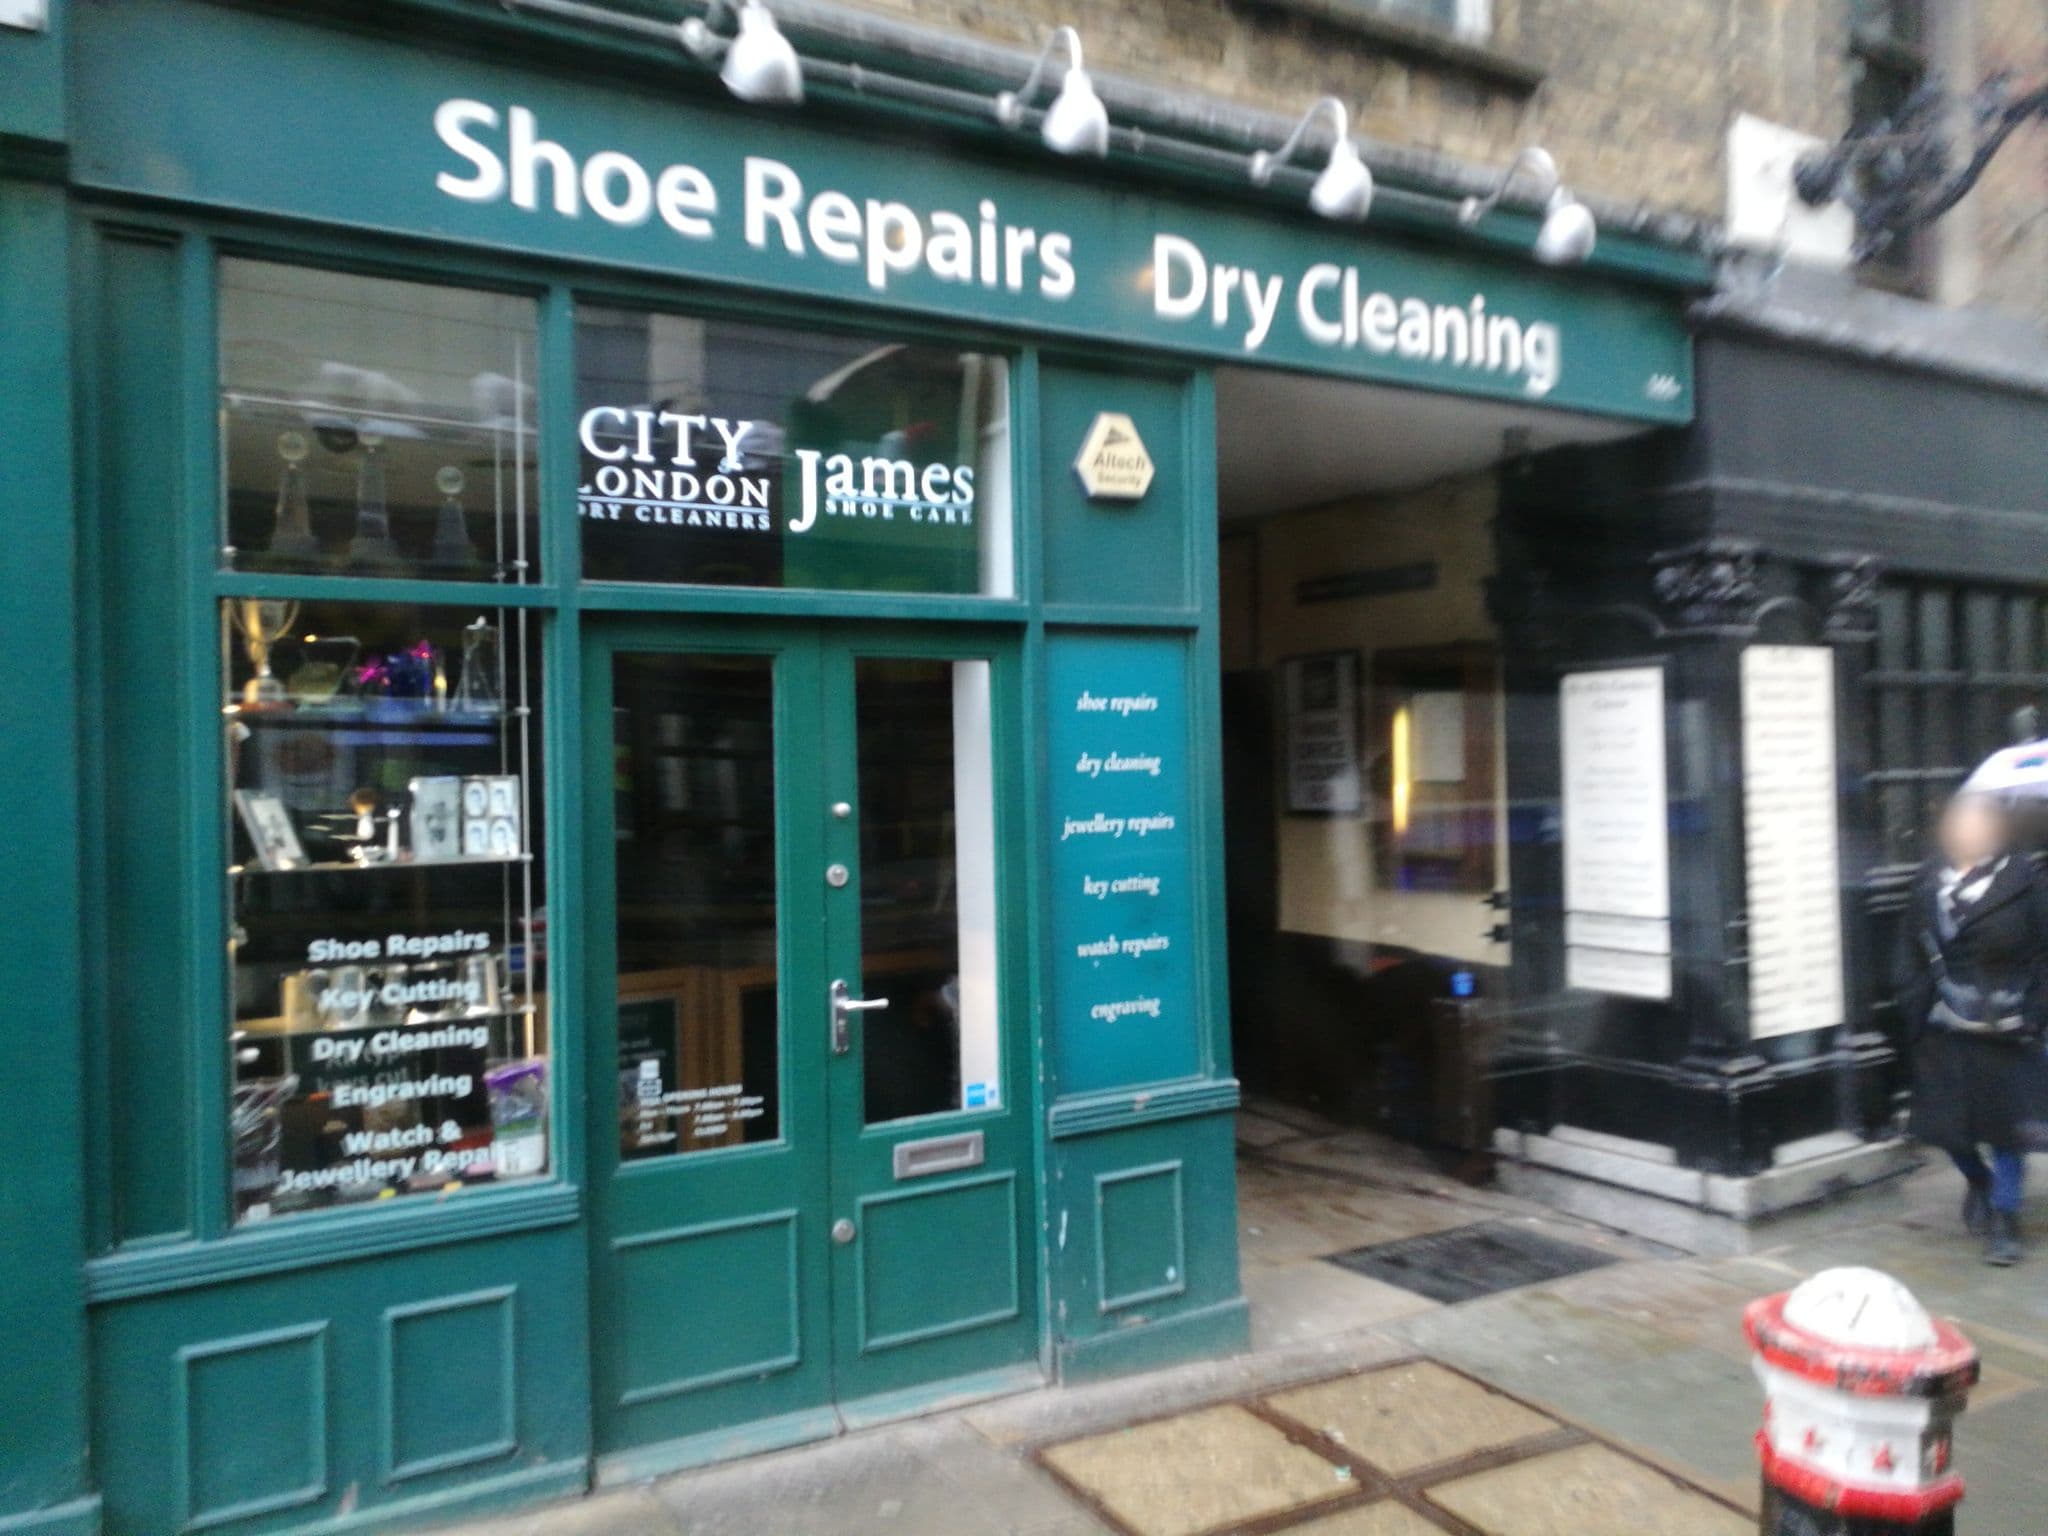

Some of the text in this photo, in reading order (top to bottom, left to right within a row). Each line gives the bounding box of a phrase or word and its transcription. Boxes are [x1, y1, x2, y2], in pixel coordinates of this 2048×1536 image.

[433, 98, 1076, 299] Shoe Repairs
[1153, 233, 1560, 397] Dry Cleaning
[579, 405, 753, 471] CITY
[788, 448, 974, 533] James
[634, 504, 770, 531] CLEANERS
[825, 498, 894, 520] SHOE
[1076, 690, 1159, 717] shoe repairs
[1076, 751, 1162, 779] dry cleaning
[1127, 811, 1176, 837] repairs
[307, 929, 491, 963] Shoe Repairs
[1121, 932, 1170, 957] repairs
[318, 977, 482, 1010] Key Cutting
[311, 1037, 366, 1062] Dry
[370, 1024, 490, 1056] Cleaning
[331, 1073, 474, 1109] Engraving
[343, 1119, 464, 1155] Watch &
[271, 1155, 418, 1196] Jewellery
